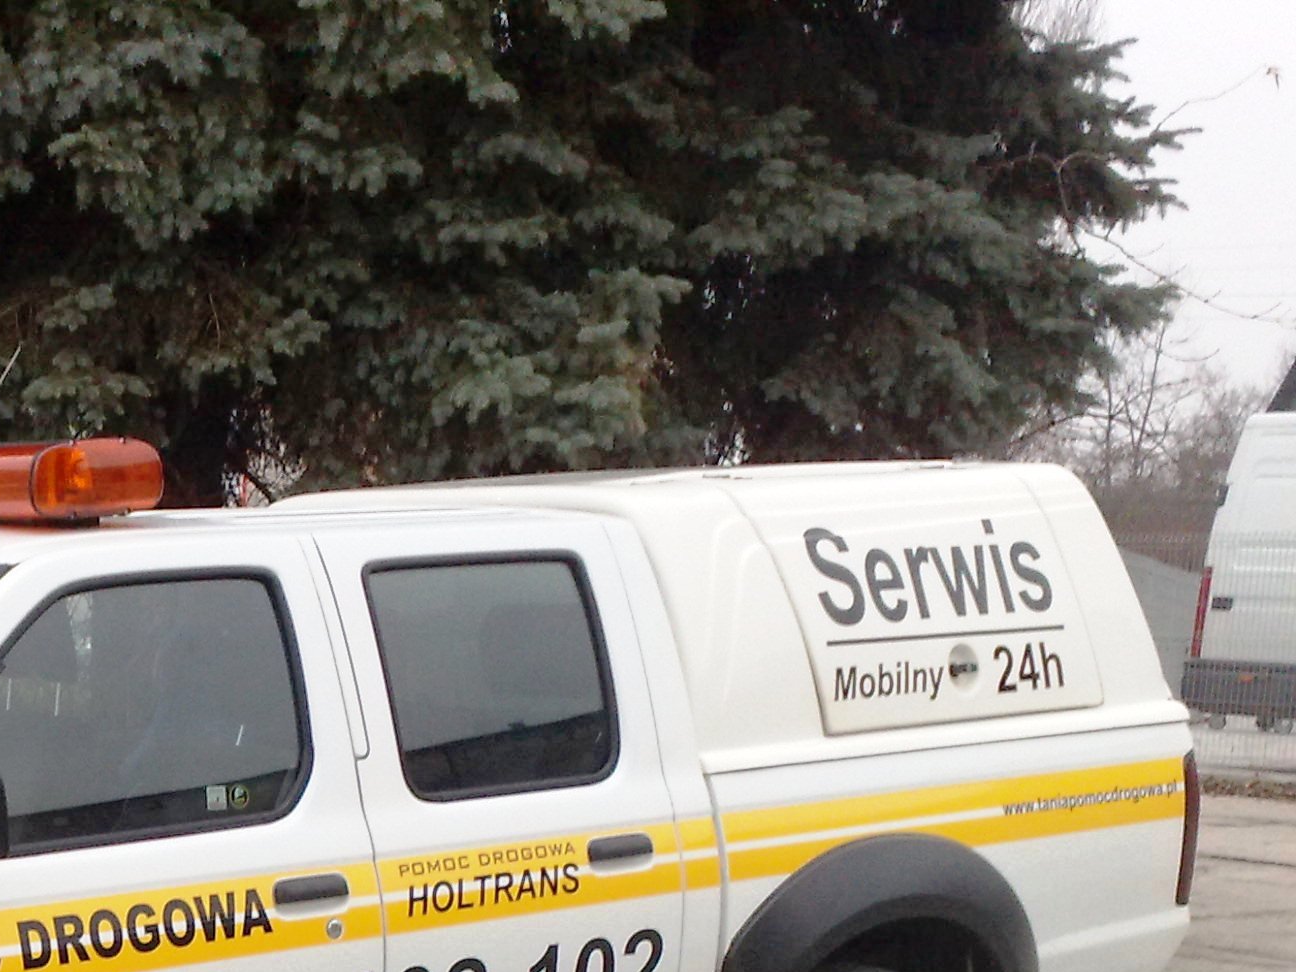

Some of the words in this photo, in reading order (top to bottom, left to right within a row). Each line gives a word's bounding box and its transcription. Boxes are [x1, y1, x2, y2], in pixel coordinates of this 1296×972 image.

[803, 519, 1053, 626] Serwis
[834, 661, 944, 701] Mobilny
[993, 642, 1065, 694] 24h
[1003, 779, 1178, 817] www.taniapomocdrogowa.pl
[399, 855, 470, 878] POMOC
[479, 841, 576, 867] DROGOWA
[408, 863, 580, 917] HOLTRANS
[16, 889, 273, 970] DROGOWA
